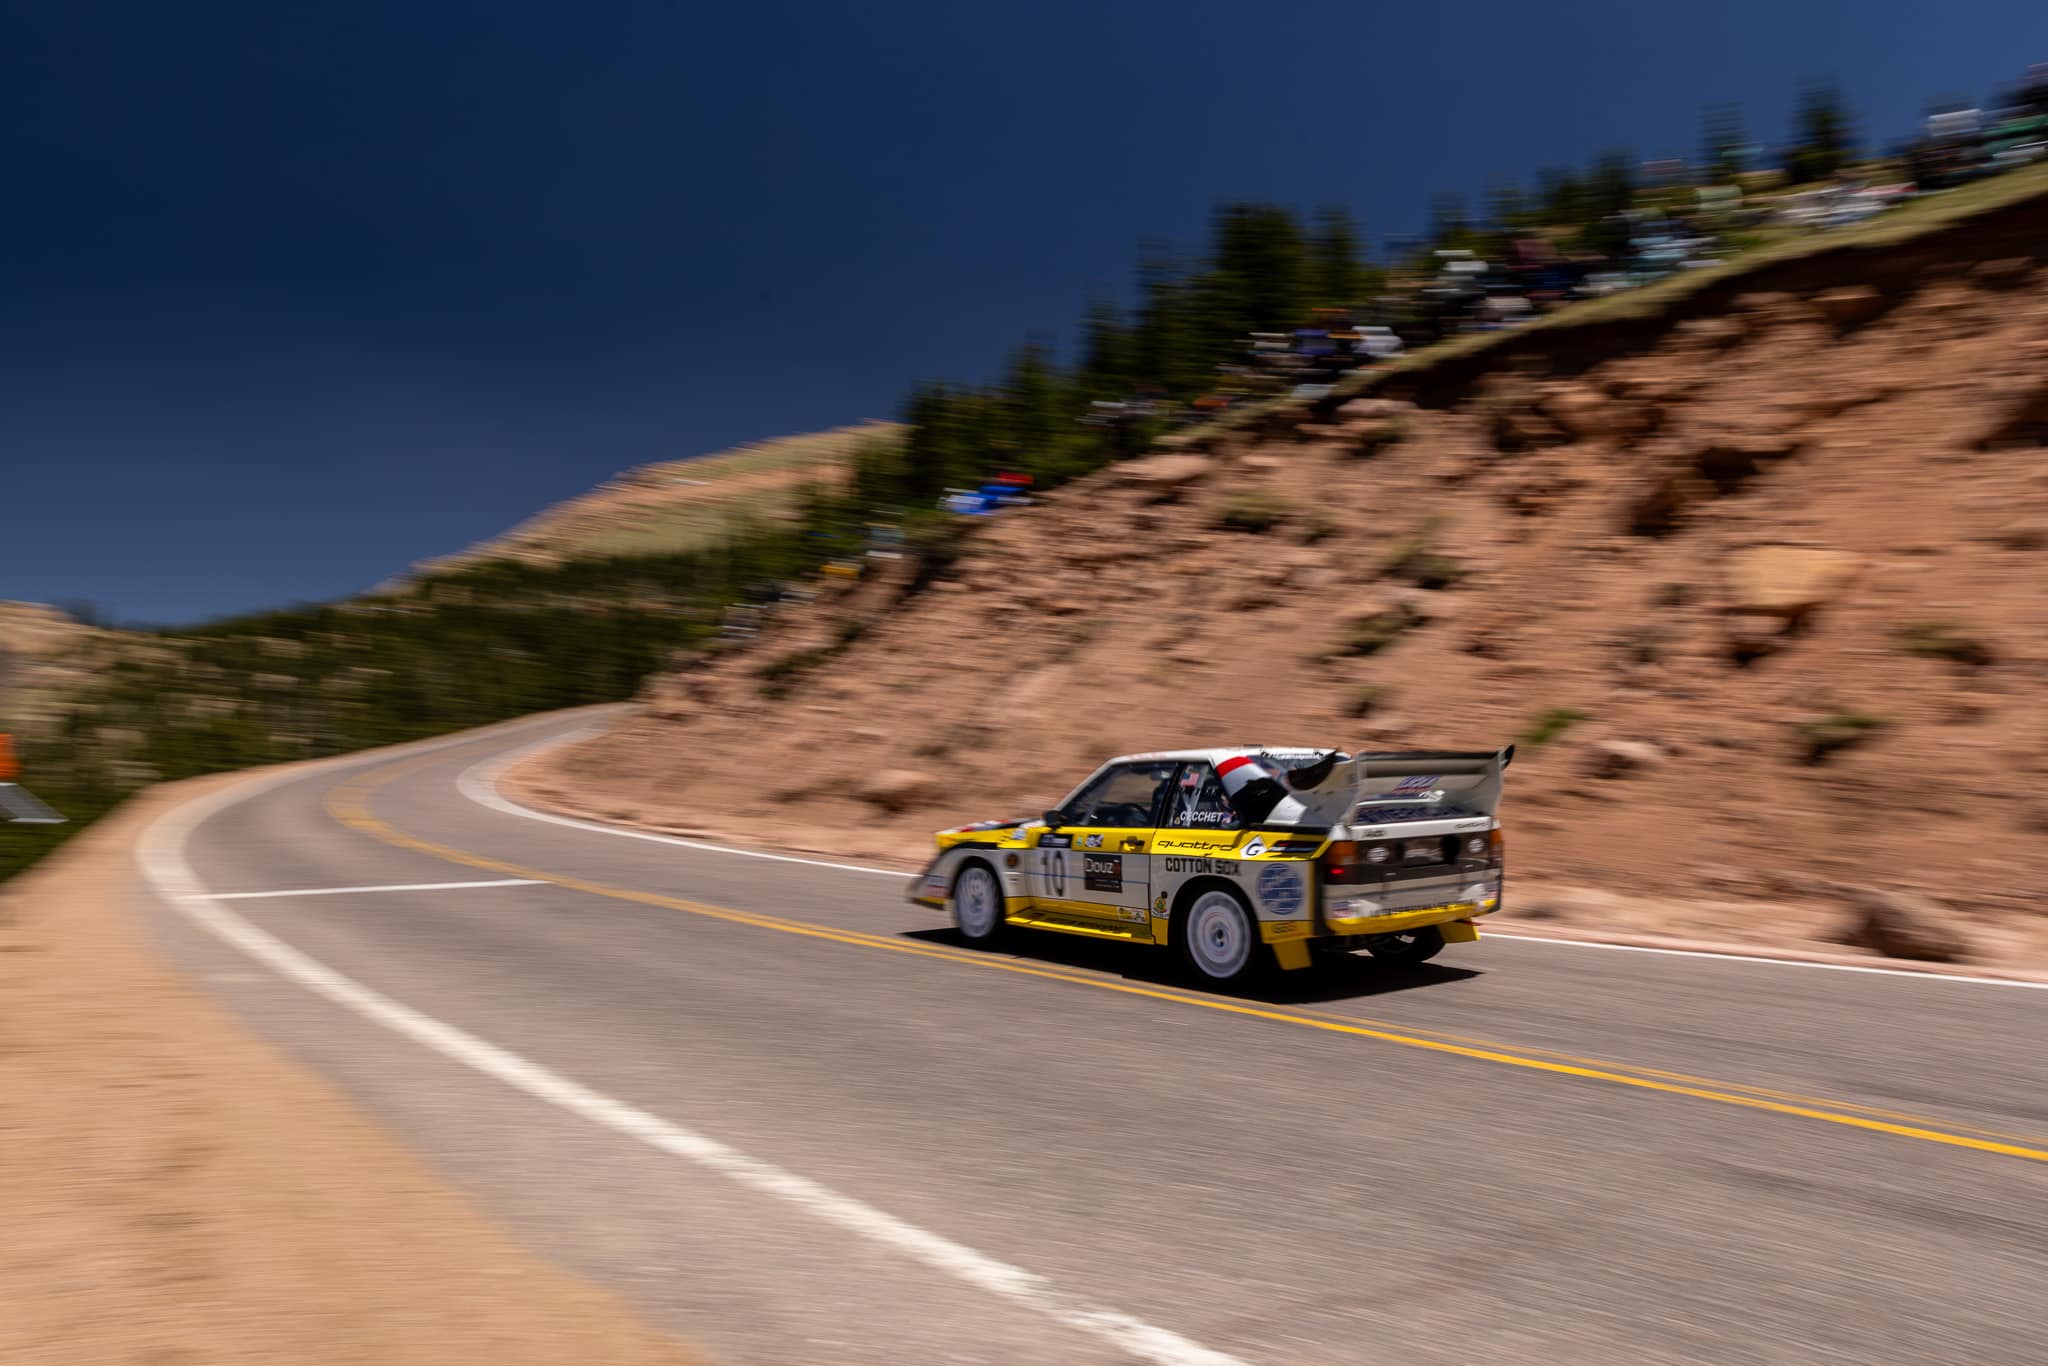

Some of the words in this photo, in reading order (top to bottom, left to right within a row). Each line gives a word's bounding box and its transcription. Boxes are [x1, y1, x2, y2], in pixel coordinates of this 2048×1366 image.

[1157, 840, 1233, 852] quattro
[1042, 849, 1065, 898] 10
[1165, 857, 1213, 874] COTTON
